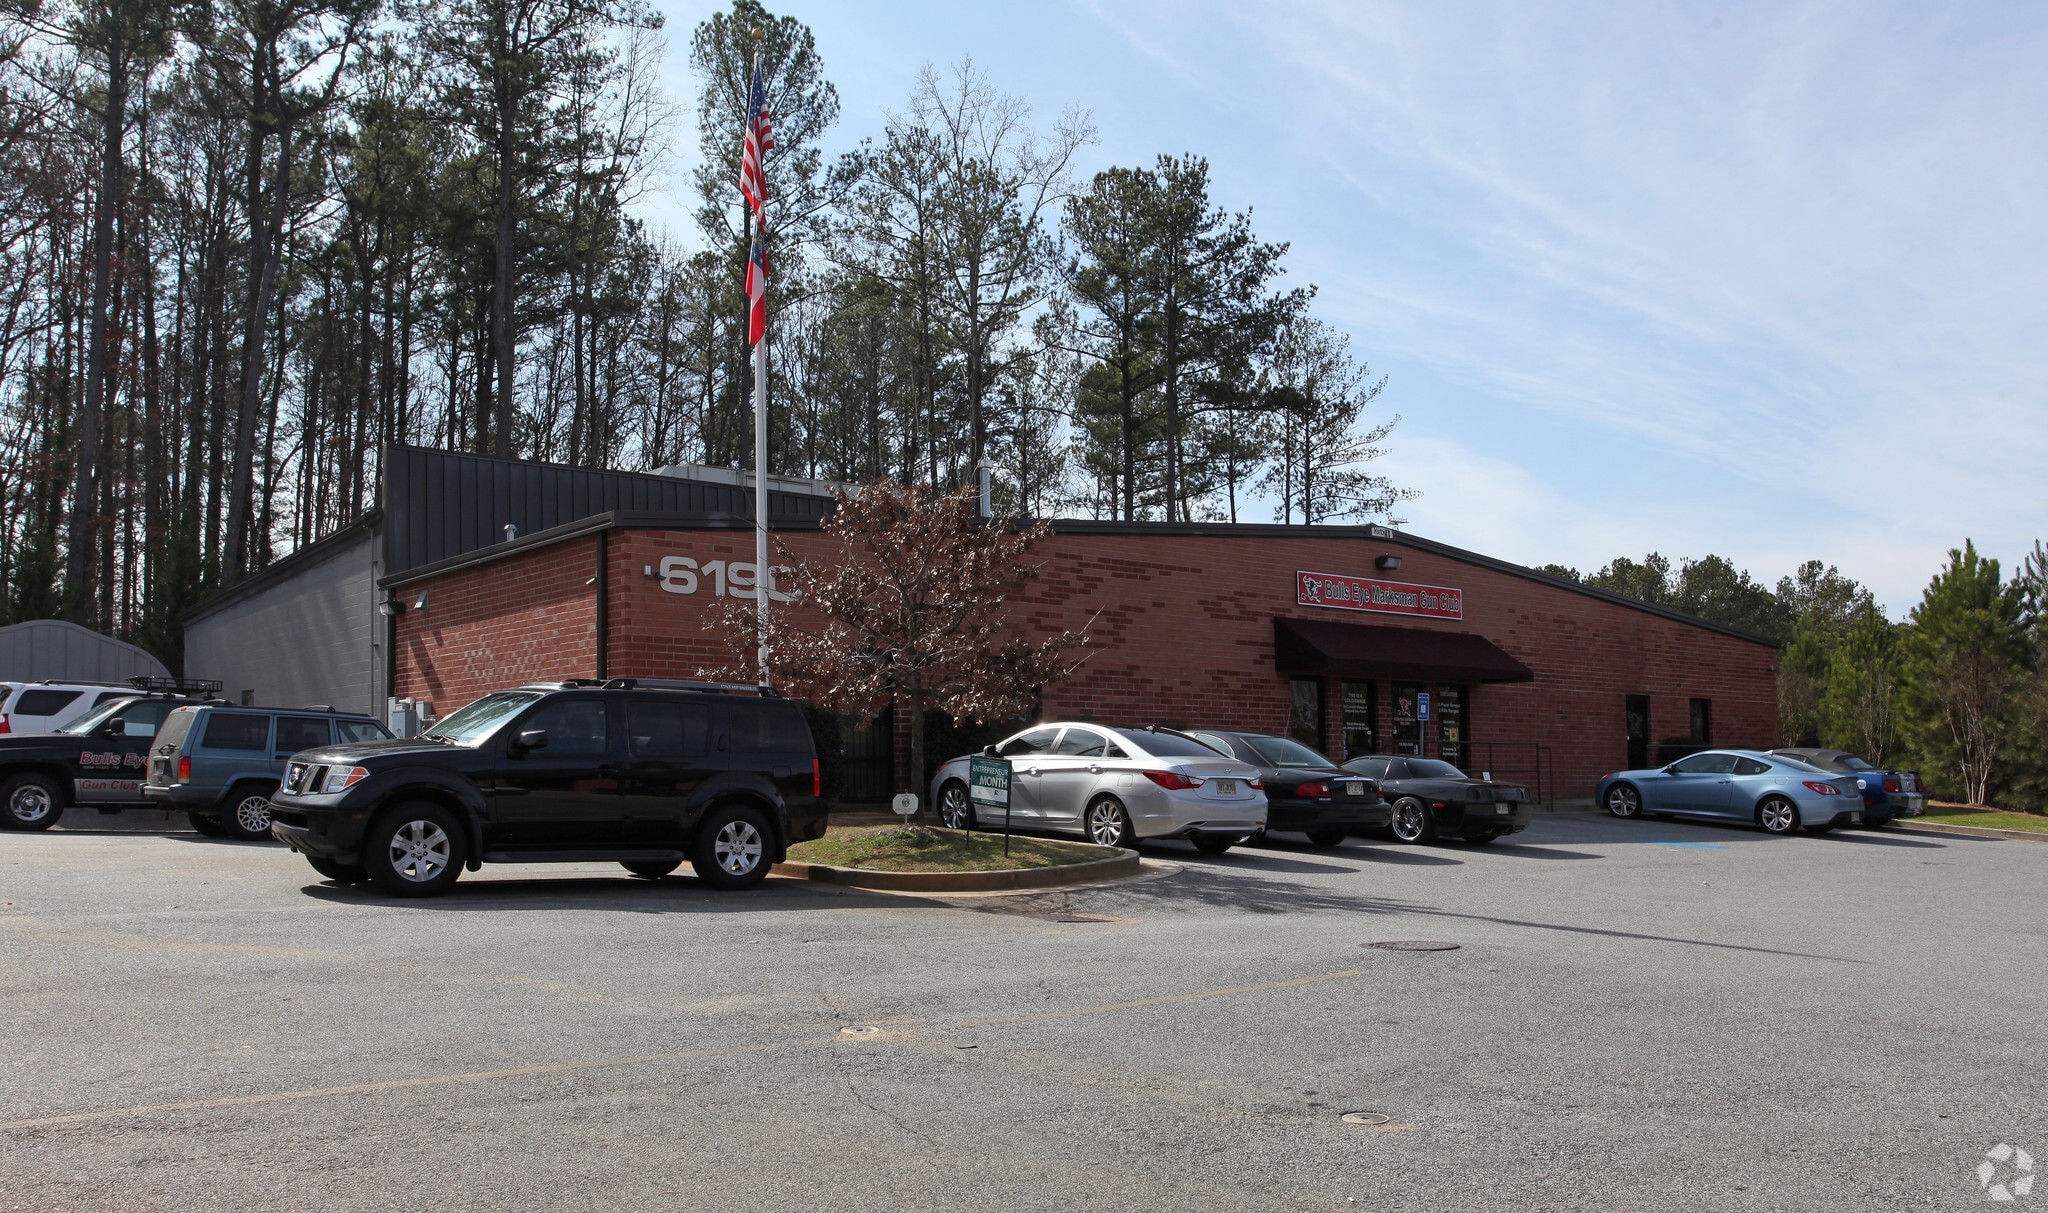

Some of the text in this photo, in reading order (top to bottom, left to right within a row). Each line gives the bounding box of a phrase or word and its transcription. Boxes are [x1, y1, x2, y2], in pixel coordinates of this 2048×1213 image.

[1325, 579, 1459, 612] Bulls Eye Marksman Gun Club
[80, 752, 121, 765] Bulls
[972, 765, 1008, 776] ENTREPRENEUR
[82, 780, 139, 790] Gun Club
[980, 775, 1008, 789] MONTH
